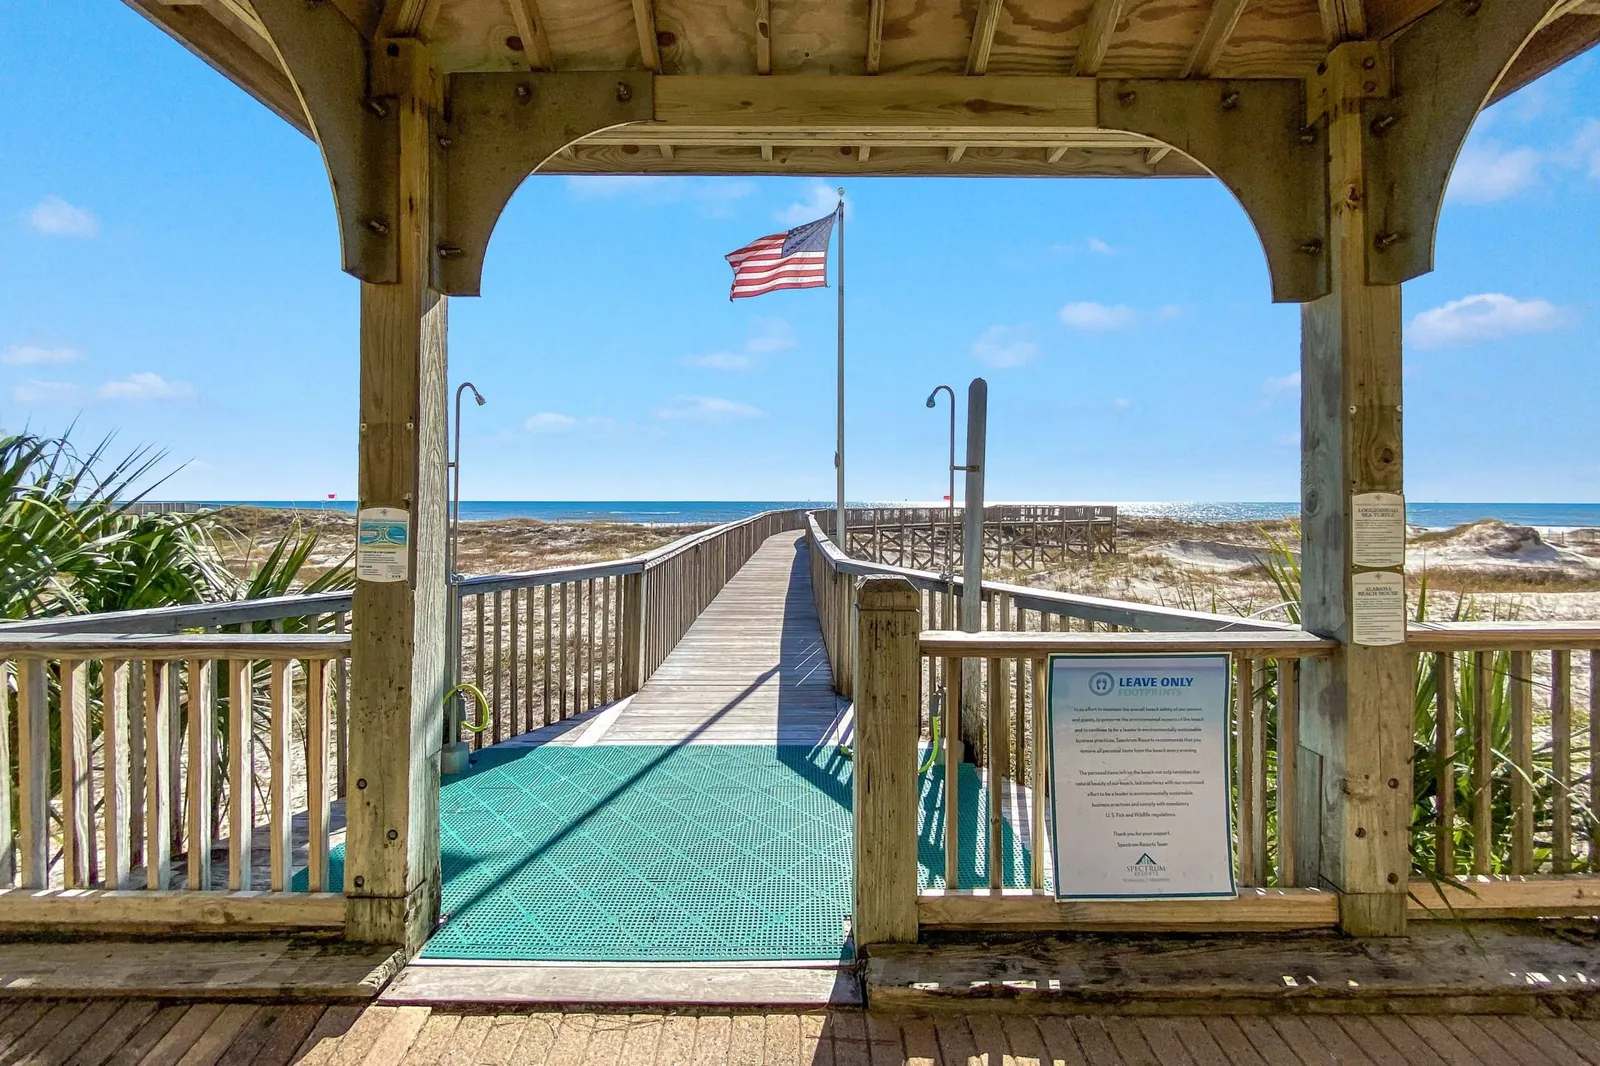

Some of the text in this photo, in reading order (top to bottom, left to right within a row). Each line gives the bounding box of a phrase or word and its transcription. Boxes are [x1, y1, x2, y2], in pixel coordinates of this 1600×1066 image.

[1119, 677, 1194, 687] LEAVE ONLY
[1118, 688, 1182, 696] FOOTPRINTS
